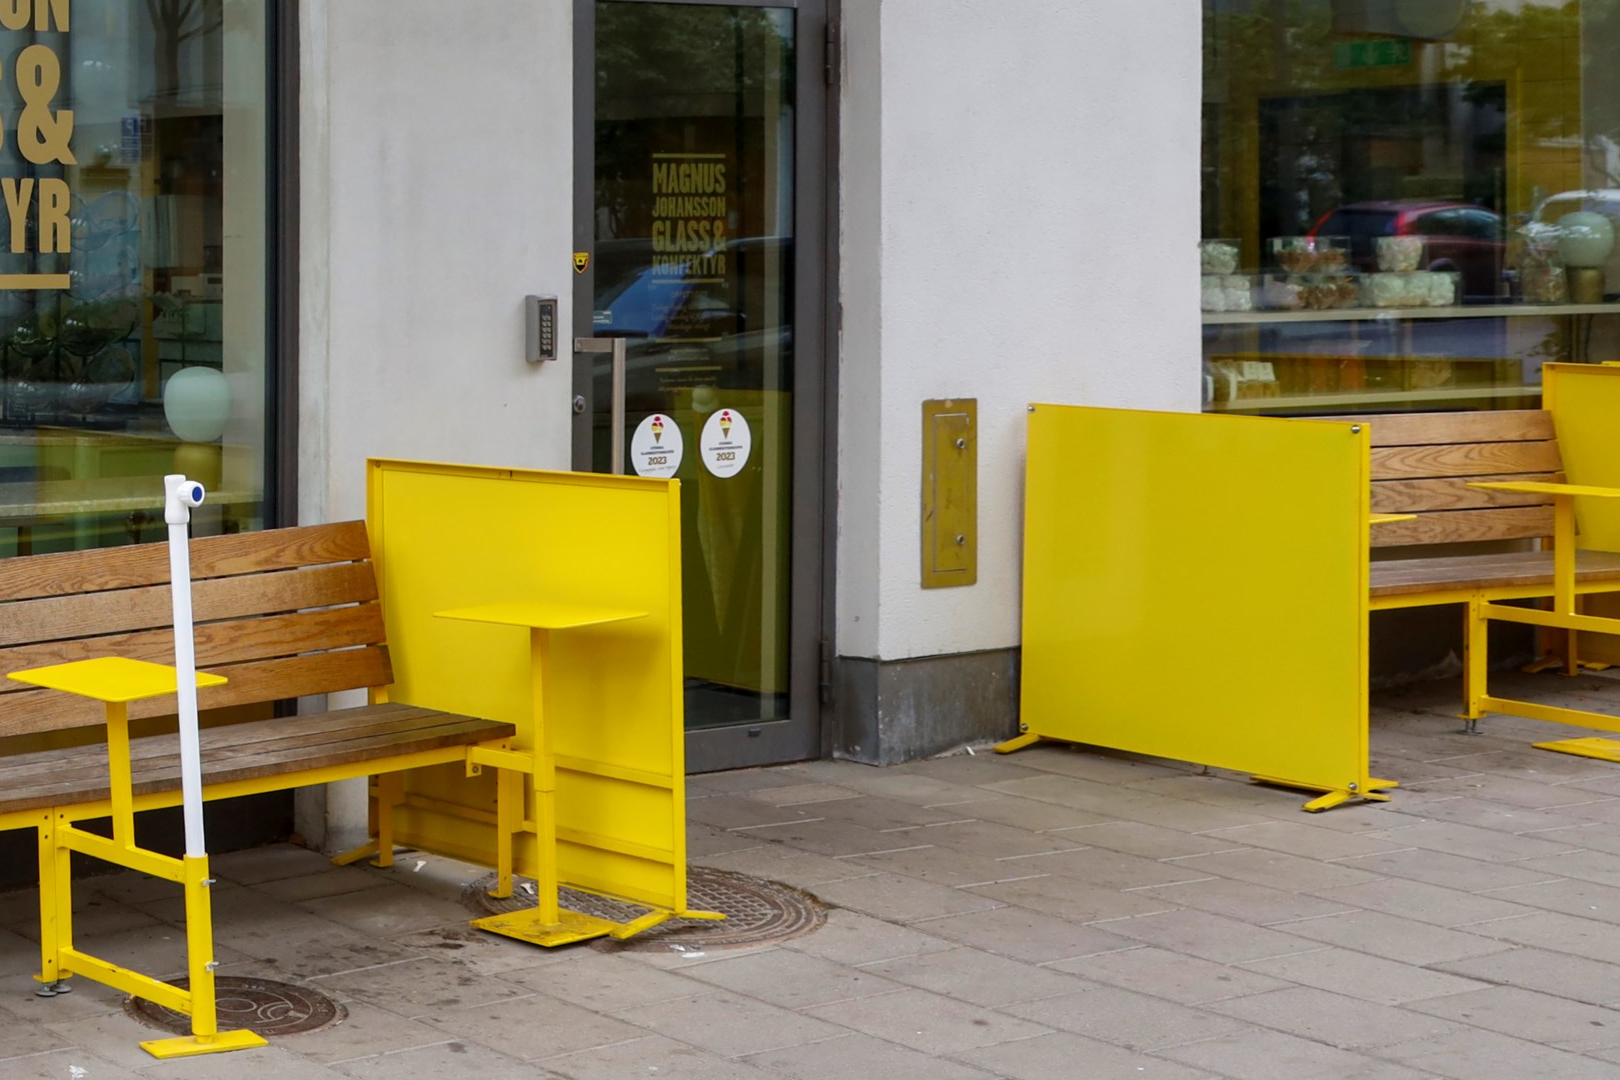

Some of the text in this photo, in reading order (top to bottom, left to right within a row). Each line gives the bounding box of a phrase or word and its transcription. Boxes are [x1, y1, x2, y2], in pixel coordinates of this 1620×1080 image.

[652, 162, 726, 194] MAGNUS
[651, 196, 726, 217] JOHANSSON
[652, 219, 711, 252] GLASS
[651, 254, 726, 275] KONFEKTYR
[647, 456, 668, 466] 2023
[716, 452, 736, 462] 2023
